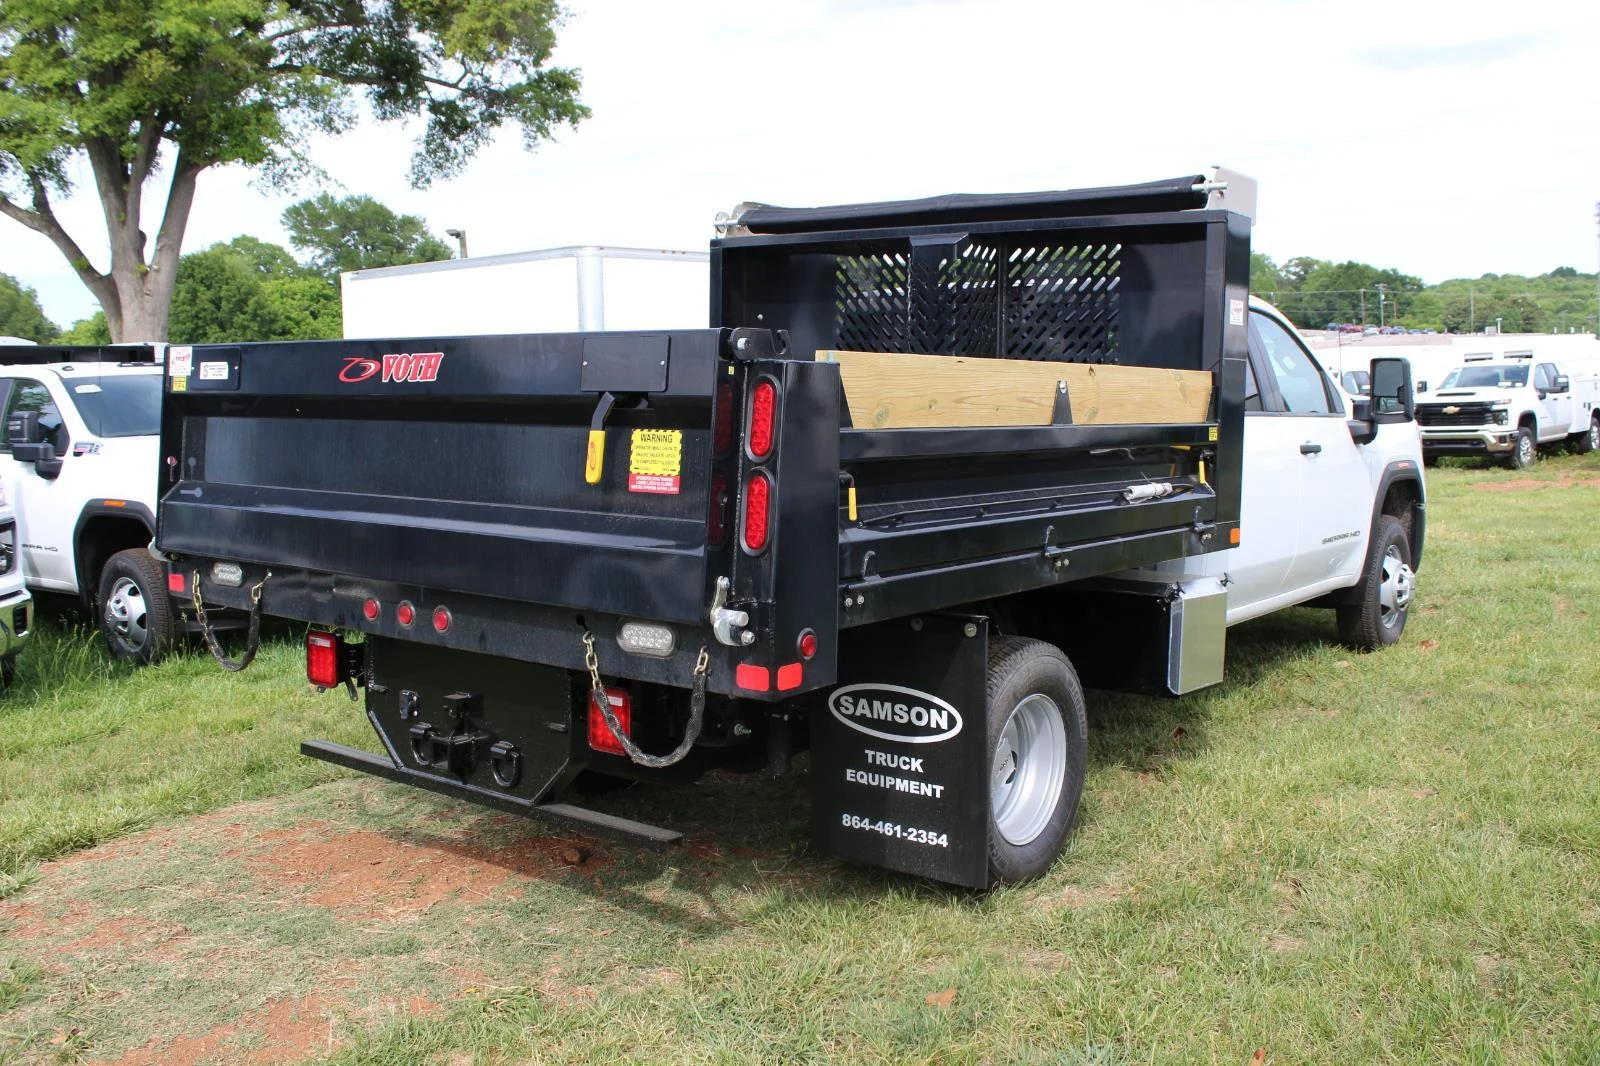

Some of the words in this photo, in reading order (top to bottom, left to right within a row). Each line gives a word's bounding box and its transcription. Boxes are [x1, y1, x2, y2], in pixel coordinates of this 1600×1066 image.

[382, 352, 444, 382] VOTH
[640, 433, 673, 443] WARNING
[839, 696, 949, 730] SAMSON
[865, 749, 924, 773] TRUCK
[846, 769, 945, 798] EQUIPMENT
[842, 813, 949, 848] 864-461-2354
